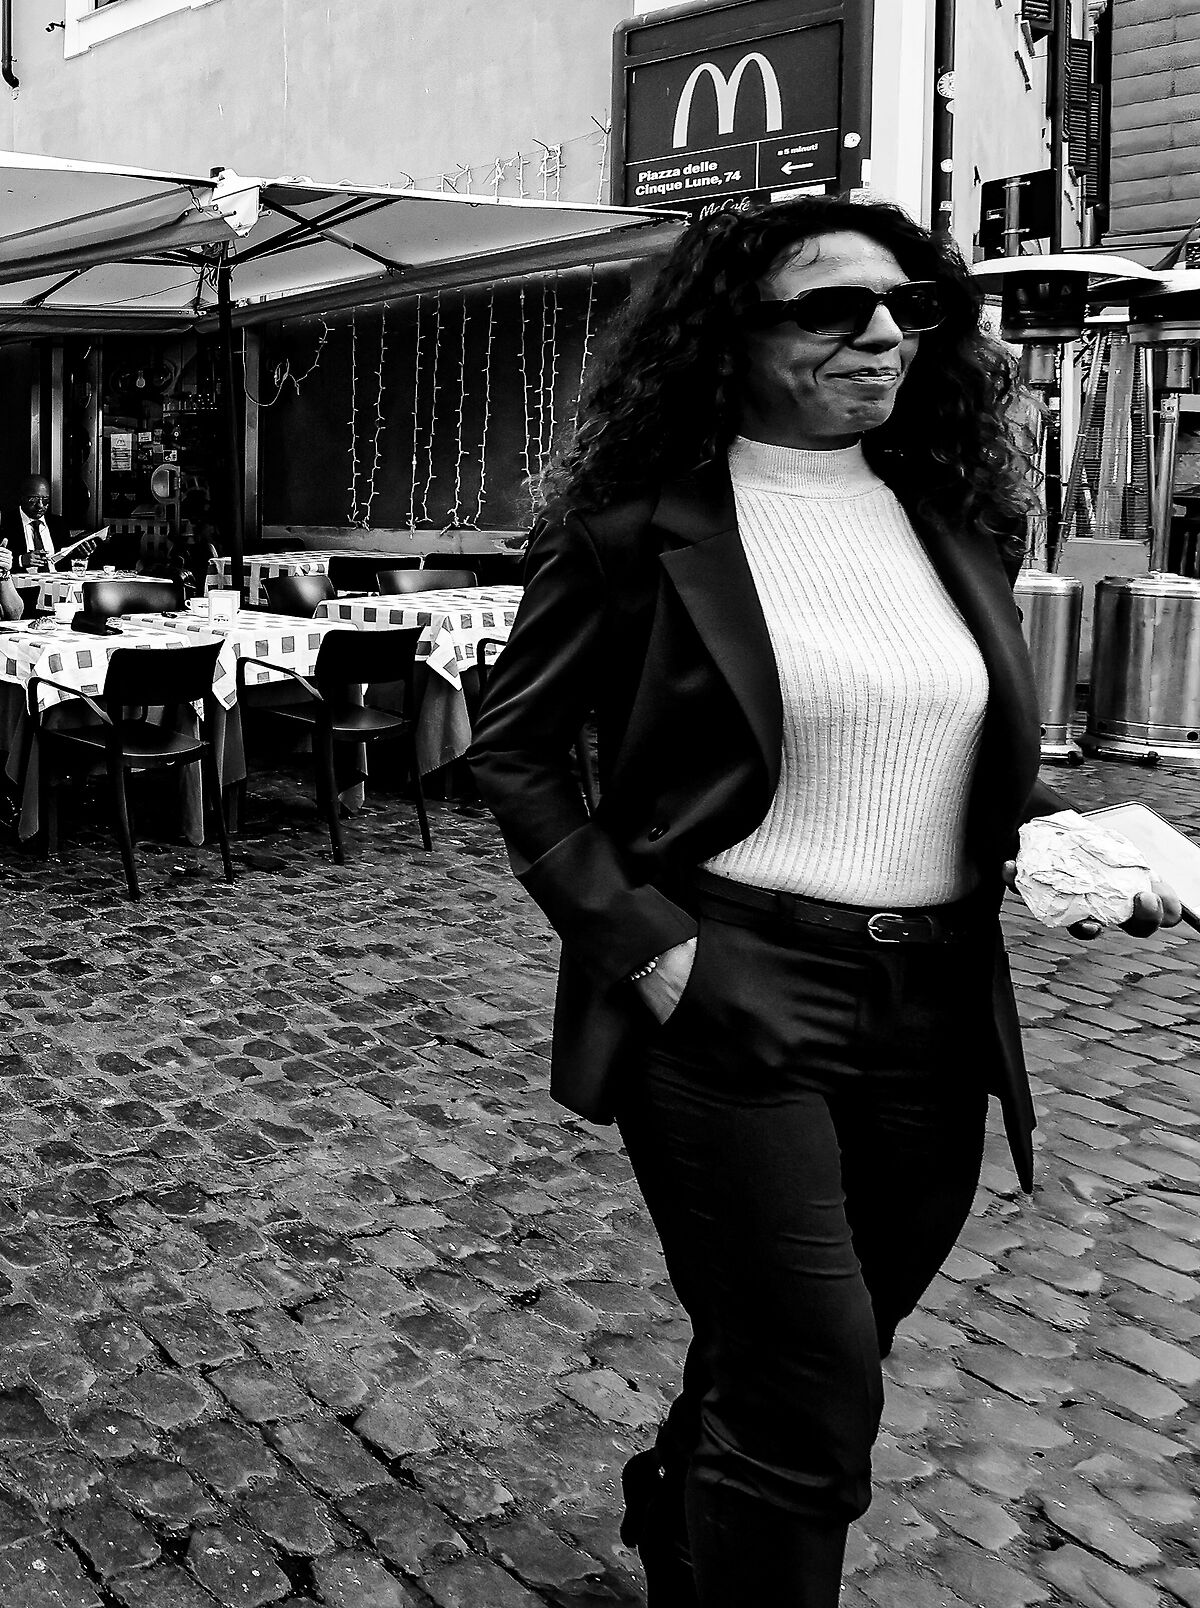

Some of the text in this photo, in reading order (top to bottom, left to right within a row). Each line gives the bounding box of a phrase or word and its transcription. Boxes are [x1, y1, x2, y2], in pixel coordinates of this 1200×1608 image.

[790, 143, 819, 154] minuti
[635, 170, 742, 196] Cinque Lune, 74
[638, 161, 719, 183] Piazza delle
